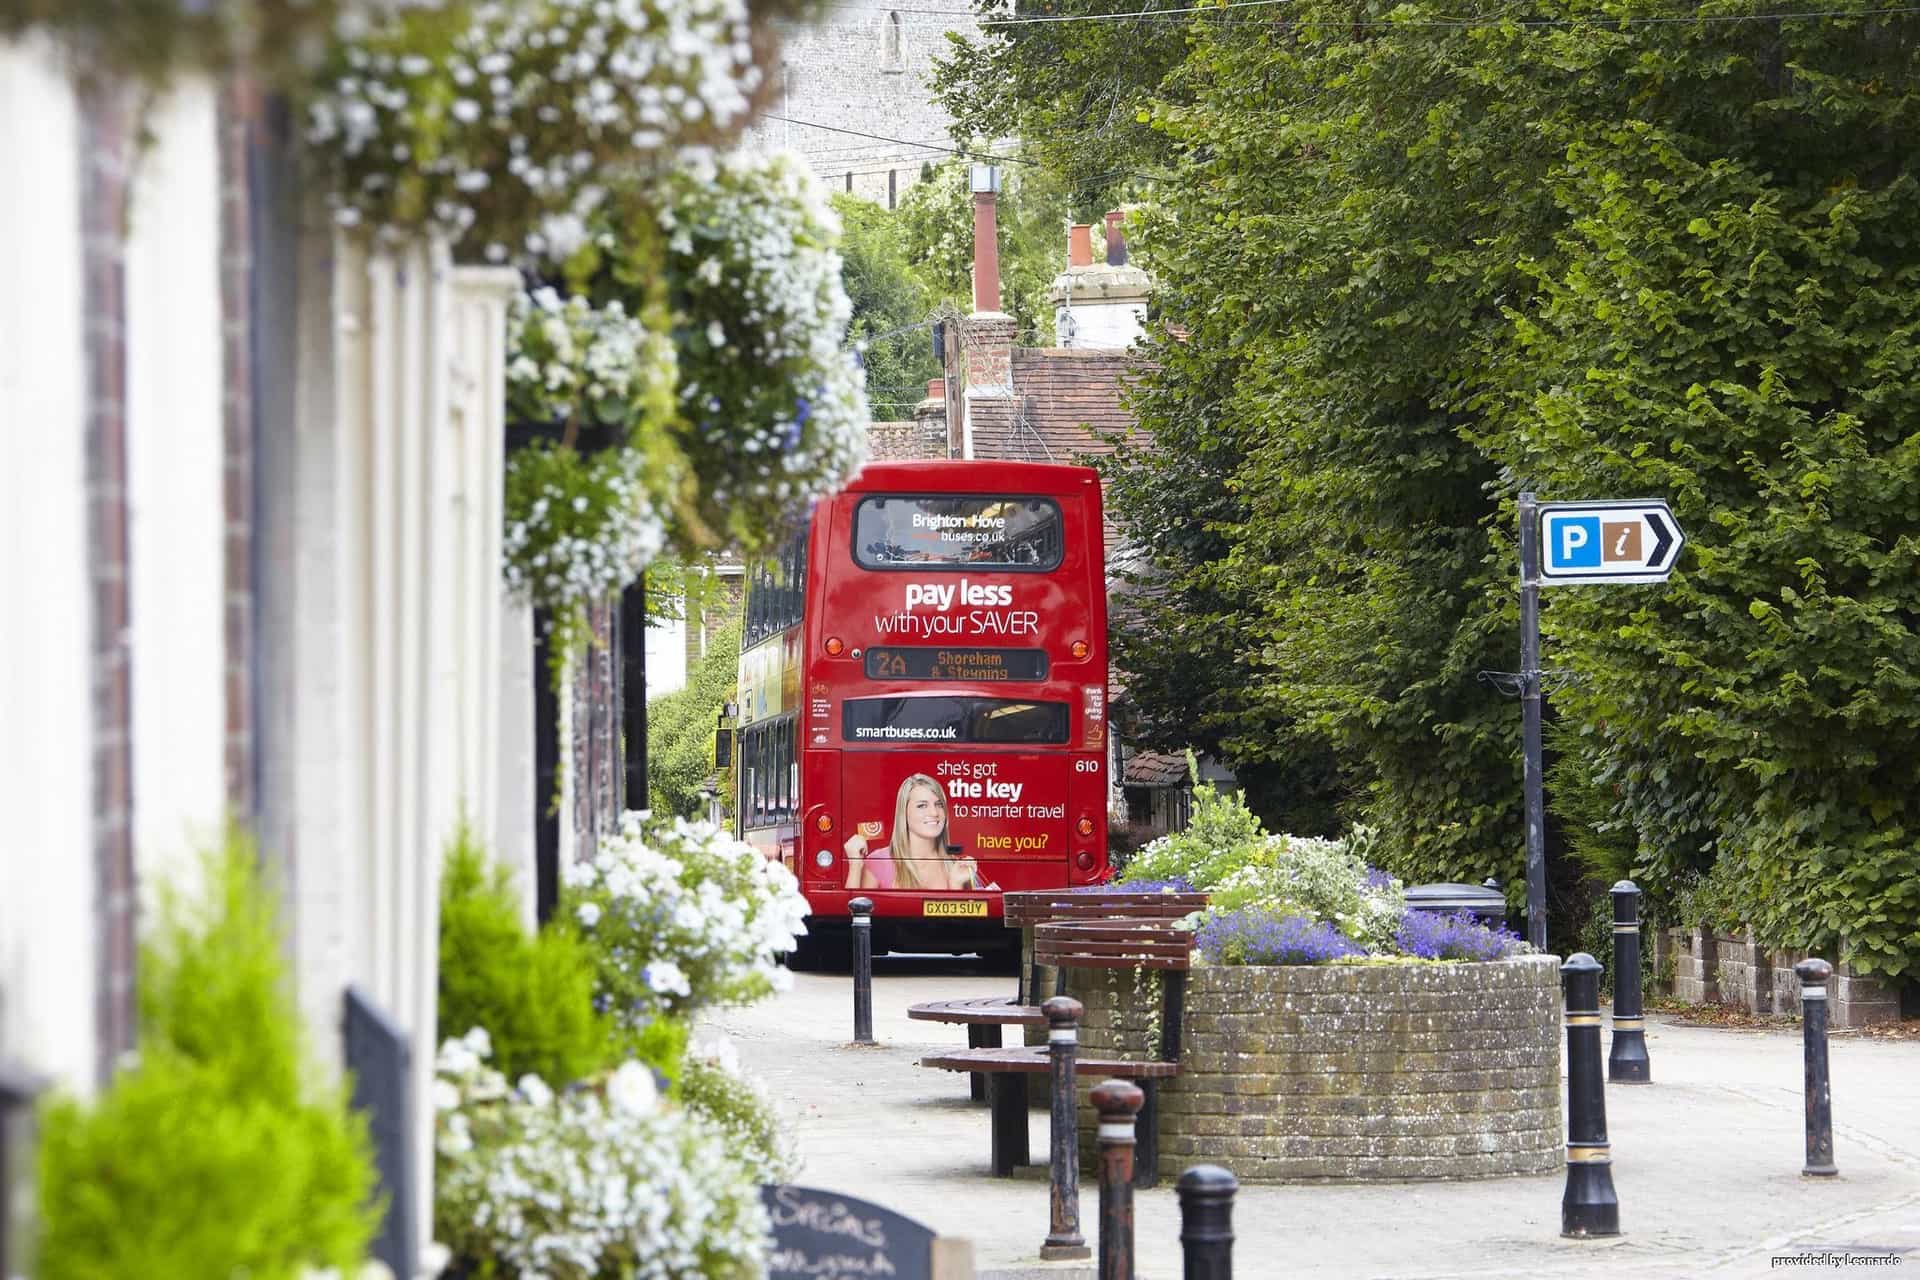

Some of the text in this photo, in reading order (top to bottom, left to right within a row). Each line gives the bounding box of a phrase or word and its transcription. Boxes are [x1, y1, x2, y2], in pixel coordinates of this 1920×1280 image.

[912, 513, 1005, 530] Brighton Hove
[941, 531, 1005, 542] buses.co.uk
[1562, 525, 1588, 560] P
[906, 579, 1012, 611] pay less
[875, 610, 1038, 638] with your SAVER
[877, 651, 1002, 675] 2A Shoreham
[856, 726, 956, 739] smartbuses.co.uk
[936, 760, 998, 778] she's got
[1075, 760, 1098, 773] 610
[948, 779, 1023, 802] the key
[953, 803, 1065, 818] to smarter travel
[977, 833, 1048, 852] have you?
[927, 903, 982, 913] GX03 SUY
